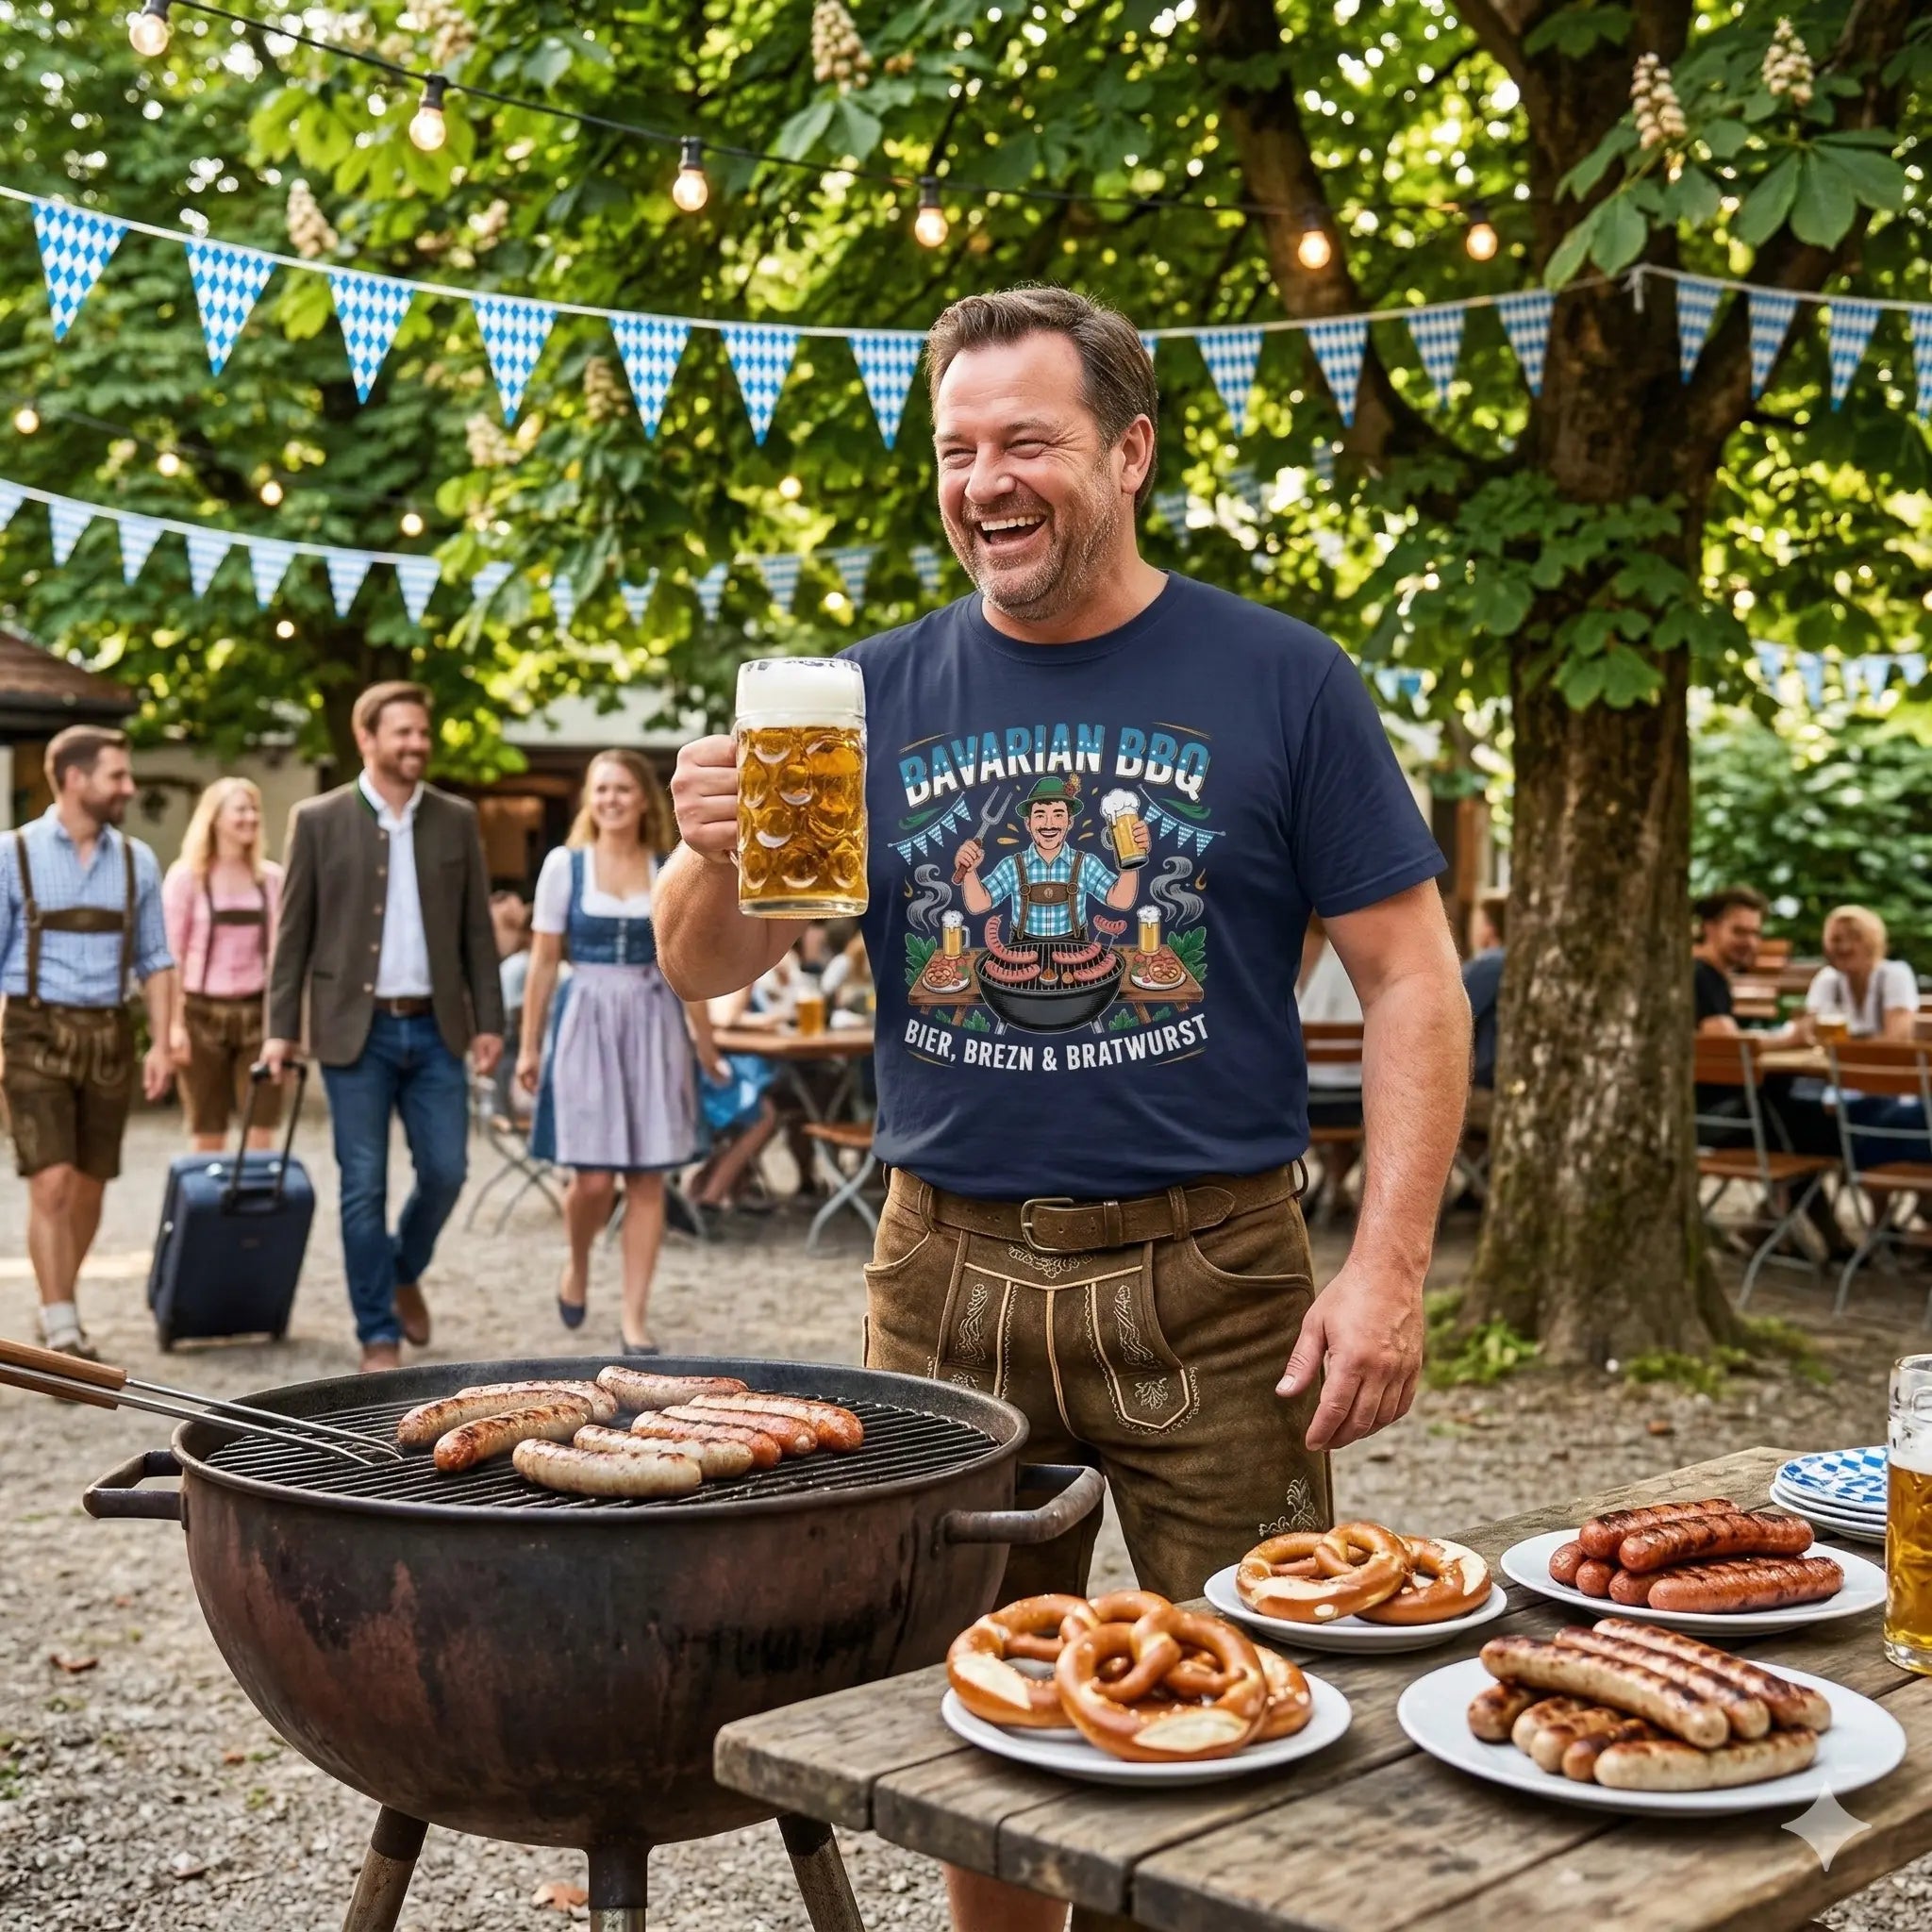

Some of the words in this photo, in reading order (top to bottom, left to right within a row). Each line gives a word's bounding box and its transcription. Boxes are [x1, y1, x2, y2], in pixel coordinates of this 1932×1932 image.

[898, 723, 1105, 808] BAVARIAN
[1115, 726, 1211, 803] BBQ
[905, 1019, 956, 1062] BIER,
[963, 1041, 1033, 1071] BREZN
[1042, 1046, 1058, 1072] &
[1066, 1013, 1208, 1071] BRATWURST
